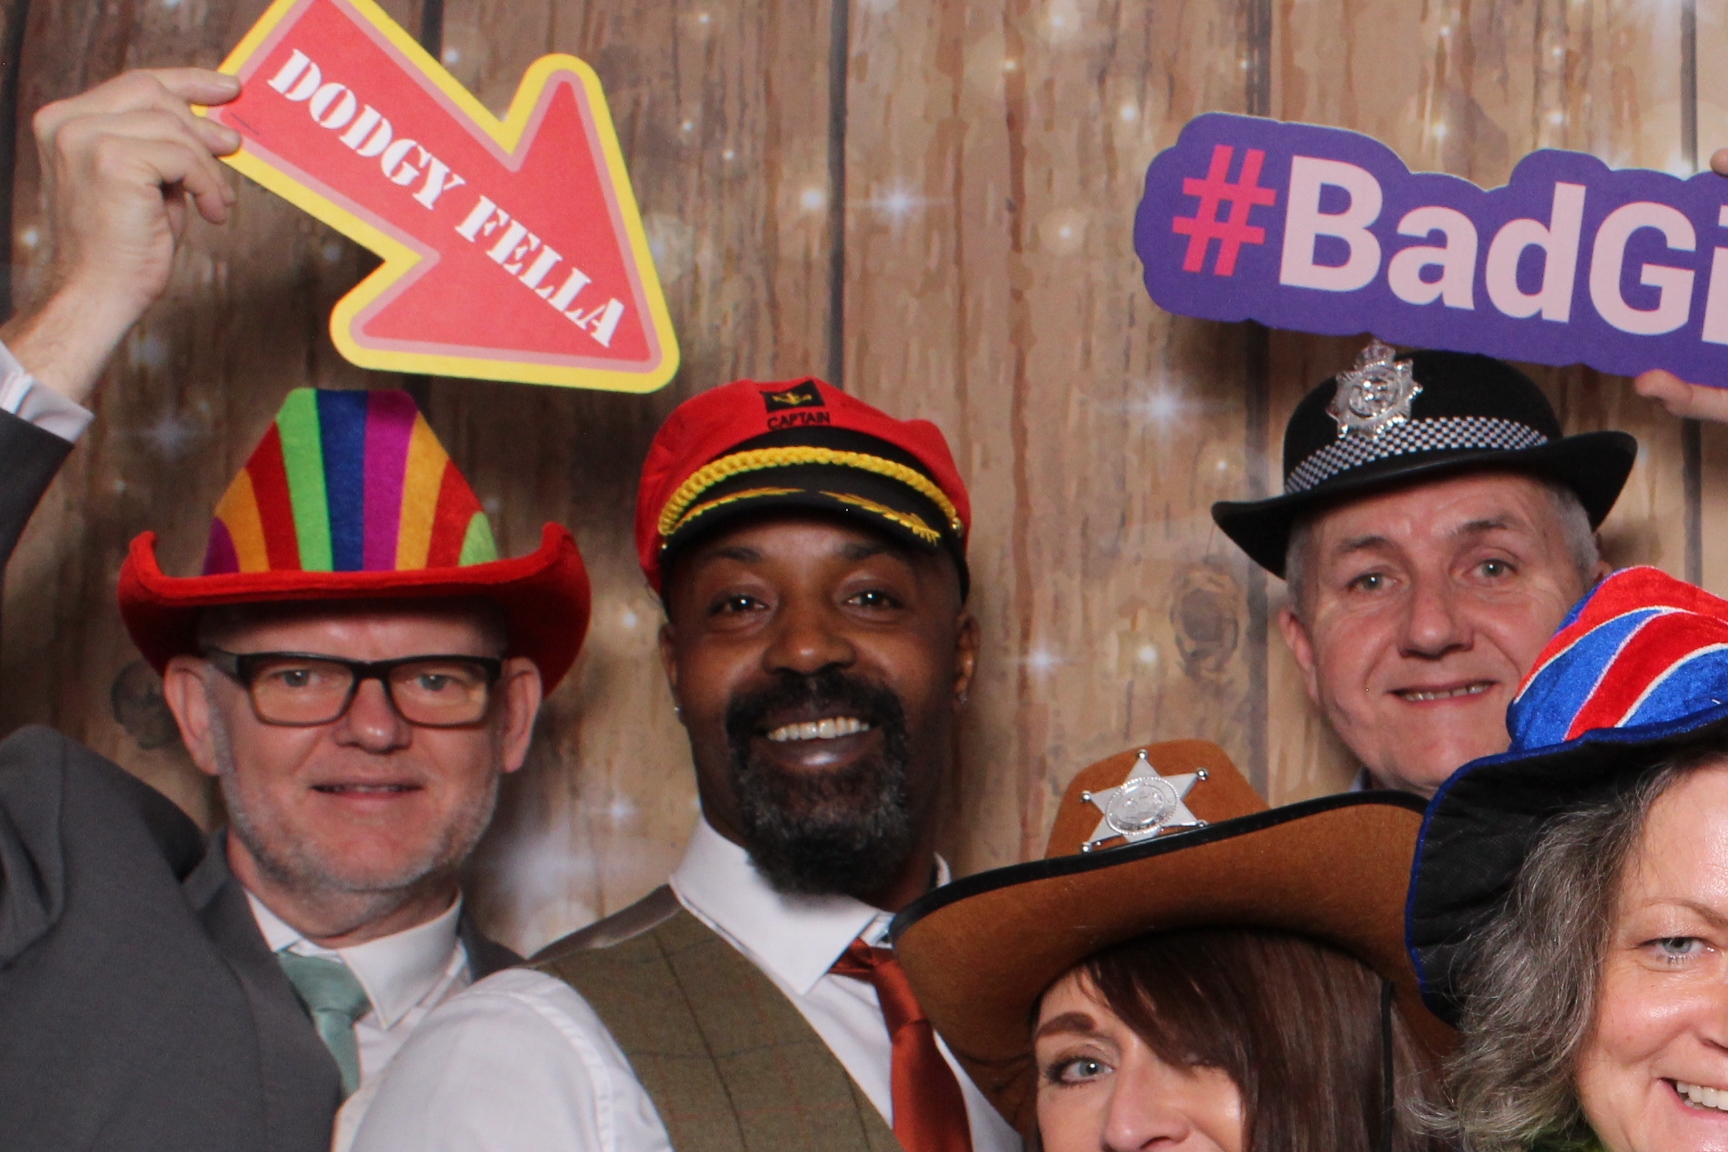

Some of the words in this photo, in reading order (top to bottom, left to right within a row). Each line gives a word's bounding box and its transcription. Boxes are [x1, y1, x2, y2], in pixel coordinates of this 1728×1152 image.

[266, 48, 466, 210] DODGY
[454, 194, 626, 347] FELLA
[767, 411, 831, 431] CAPTAIN
